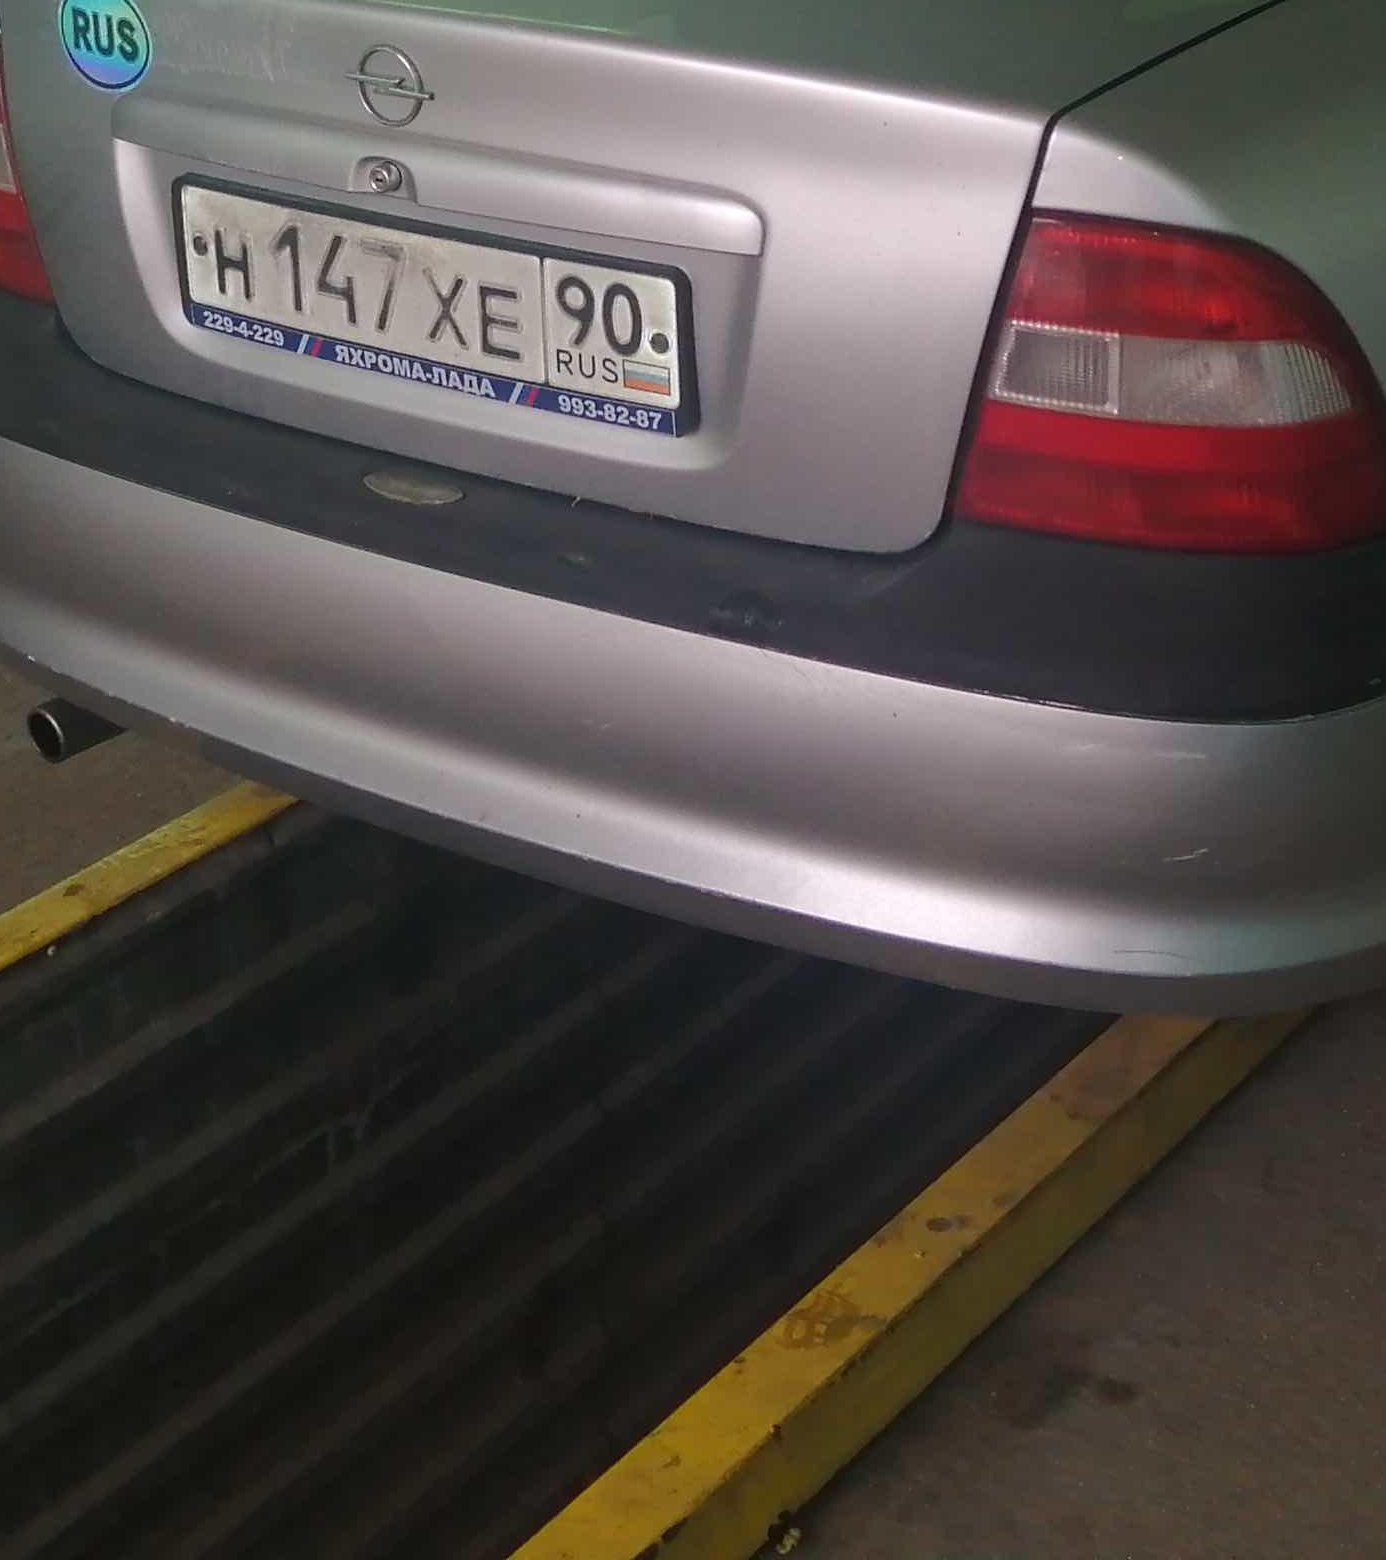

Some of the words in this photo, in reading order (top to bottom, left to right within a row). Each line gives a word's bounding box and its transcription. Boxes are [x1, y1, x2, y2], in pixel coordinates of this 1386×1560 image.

[72, 5, 140, 63] RUS
[556, 275, 642, 355] 90
[202, 309, 284, 348] 229-4-229
[334, 343, 496, 398] ЯХРОМА-ЛАДА
[557, 394, 662, 430] 993-82-87
[556, 349, 619, 384] RUS
